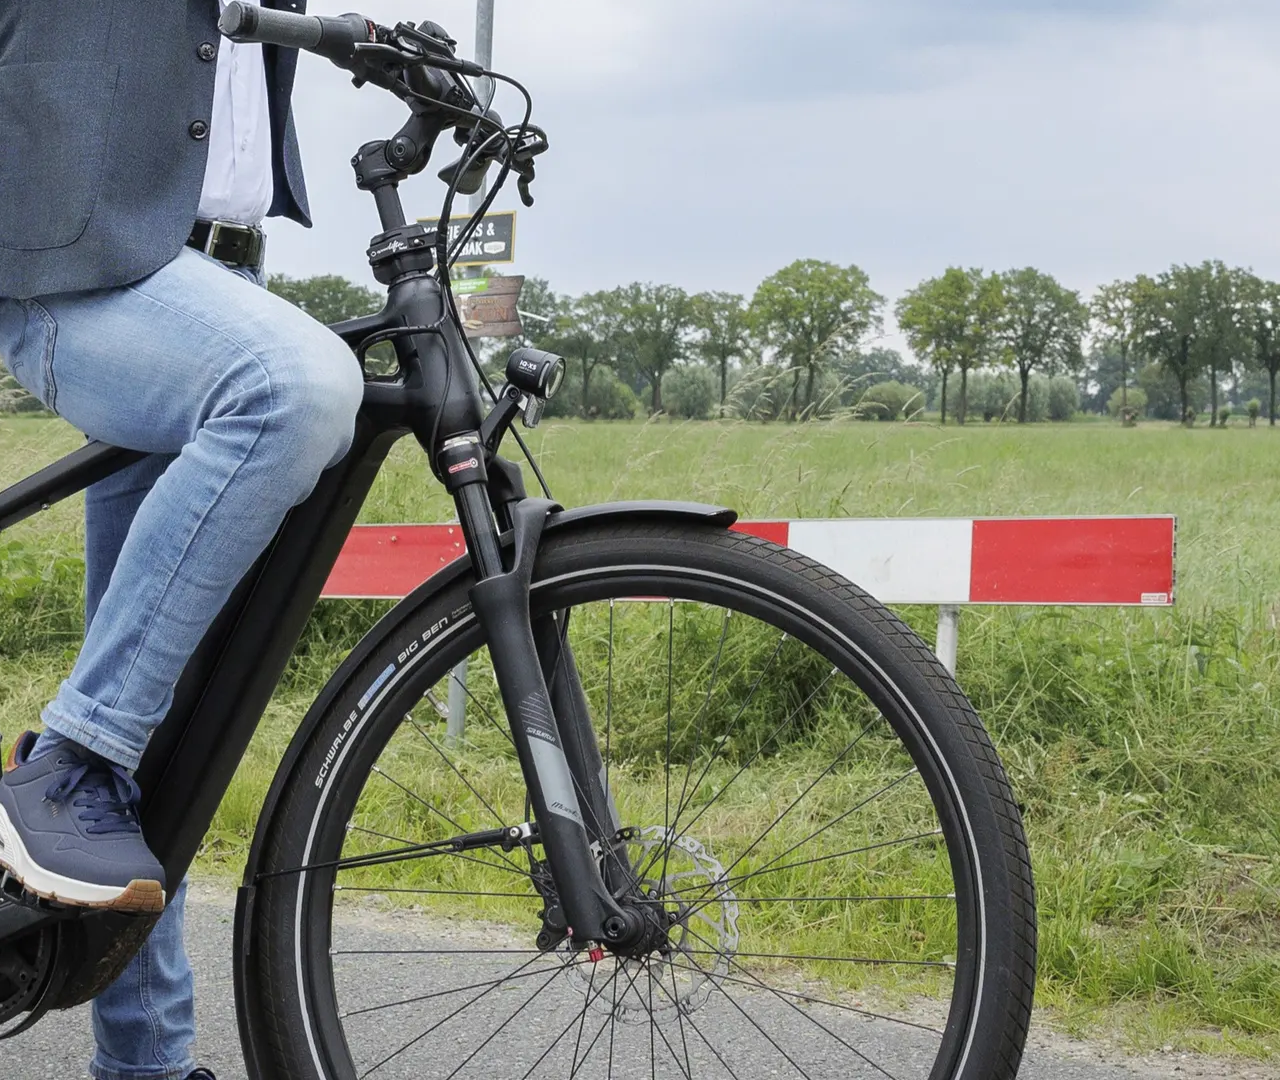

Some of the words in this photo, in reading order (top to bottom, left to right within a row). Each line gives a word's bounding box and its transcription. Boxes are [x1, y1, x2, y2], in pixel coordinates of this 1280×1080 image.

[398, 640, 419, 663] BIG
[422, 617, 448, 641] BEN
[315, 710, 358, 788] SCHWALBE
